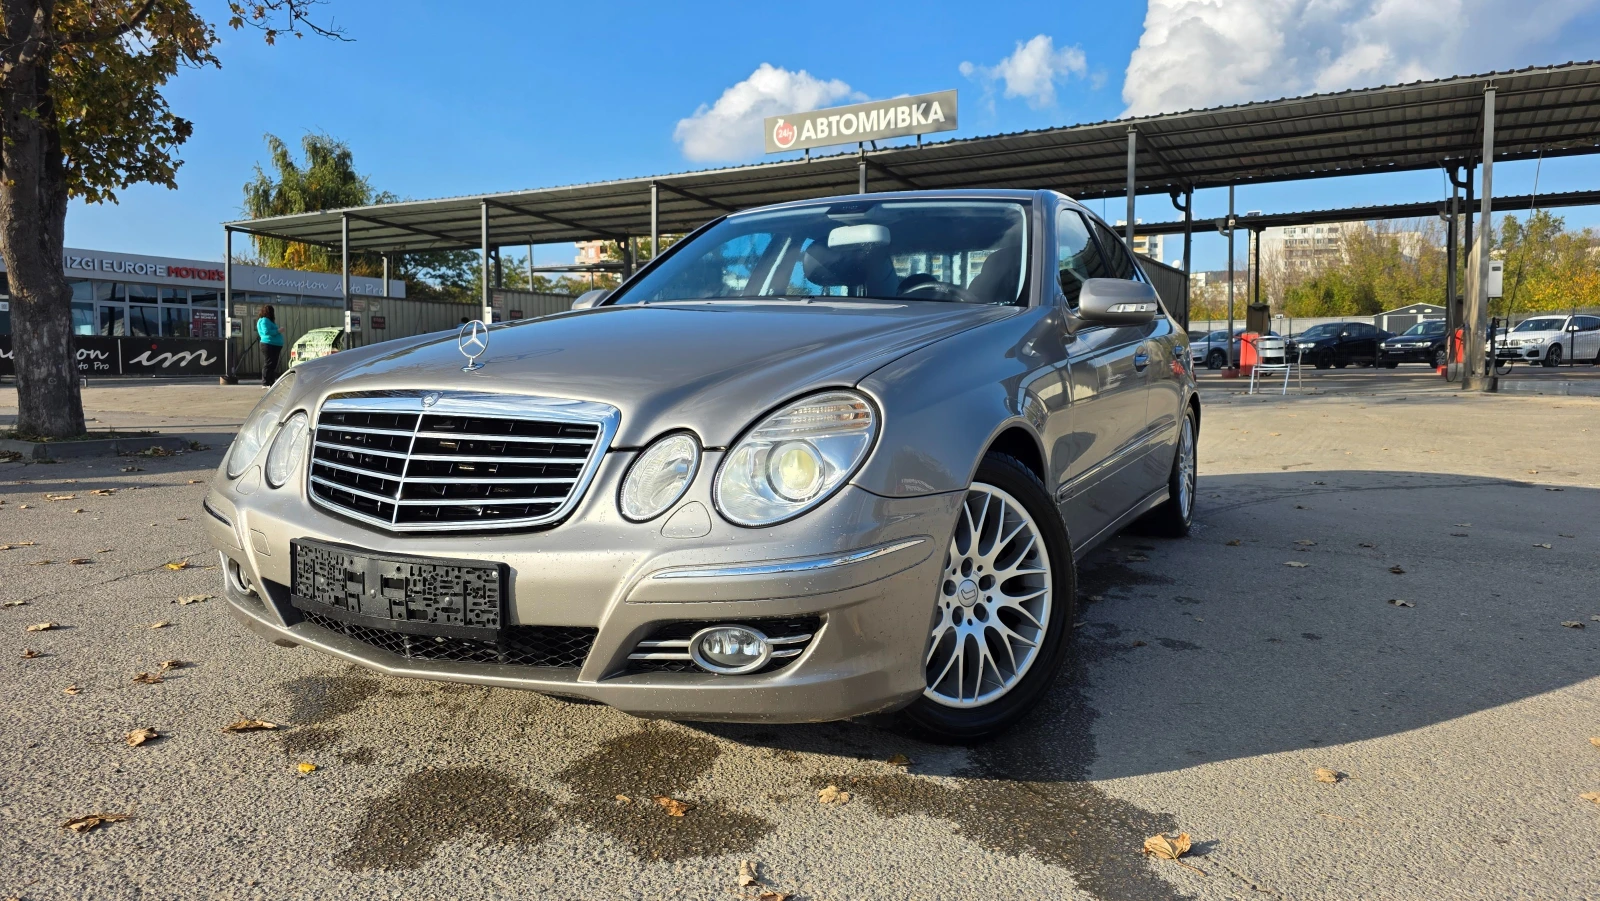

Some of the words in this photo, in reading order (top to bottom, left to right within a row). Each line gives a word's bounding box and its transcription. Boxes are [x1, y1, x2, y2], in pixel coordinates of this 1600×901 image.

[778, 128, 793, 141] 24/7
[800, 101, 945, 141] АВТОМИВКА
[66, 256, 98, 271] IZGI
[102, 260, 166, 277] EUROPE
[168, 266, 225, 282] MOTOR'S
[334, 283, 361, 293] Ato
[365, 284, 384, 295] Pro
[78, 361, 88, 370] to
[93, 361, 109, 370] Pro
